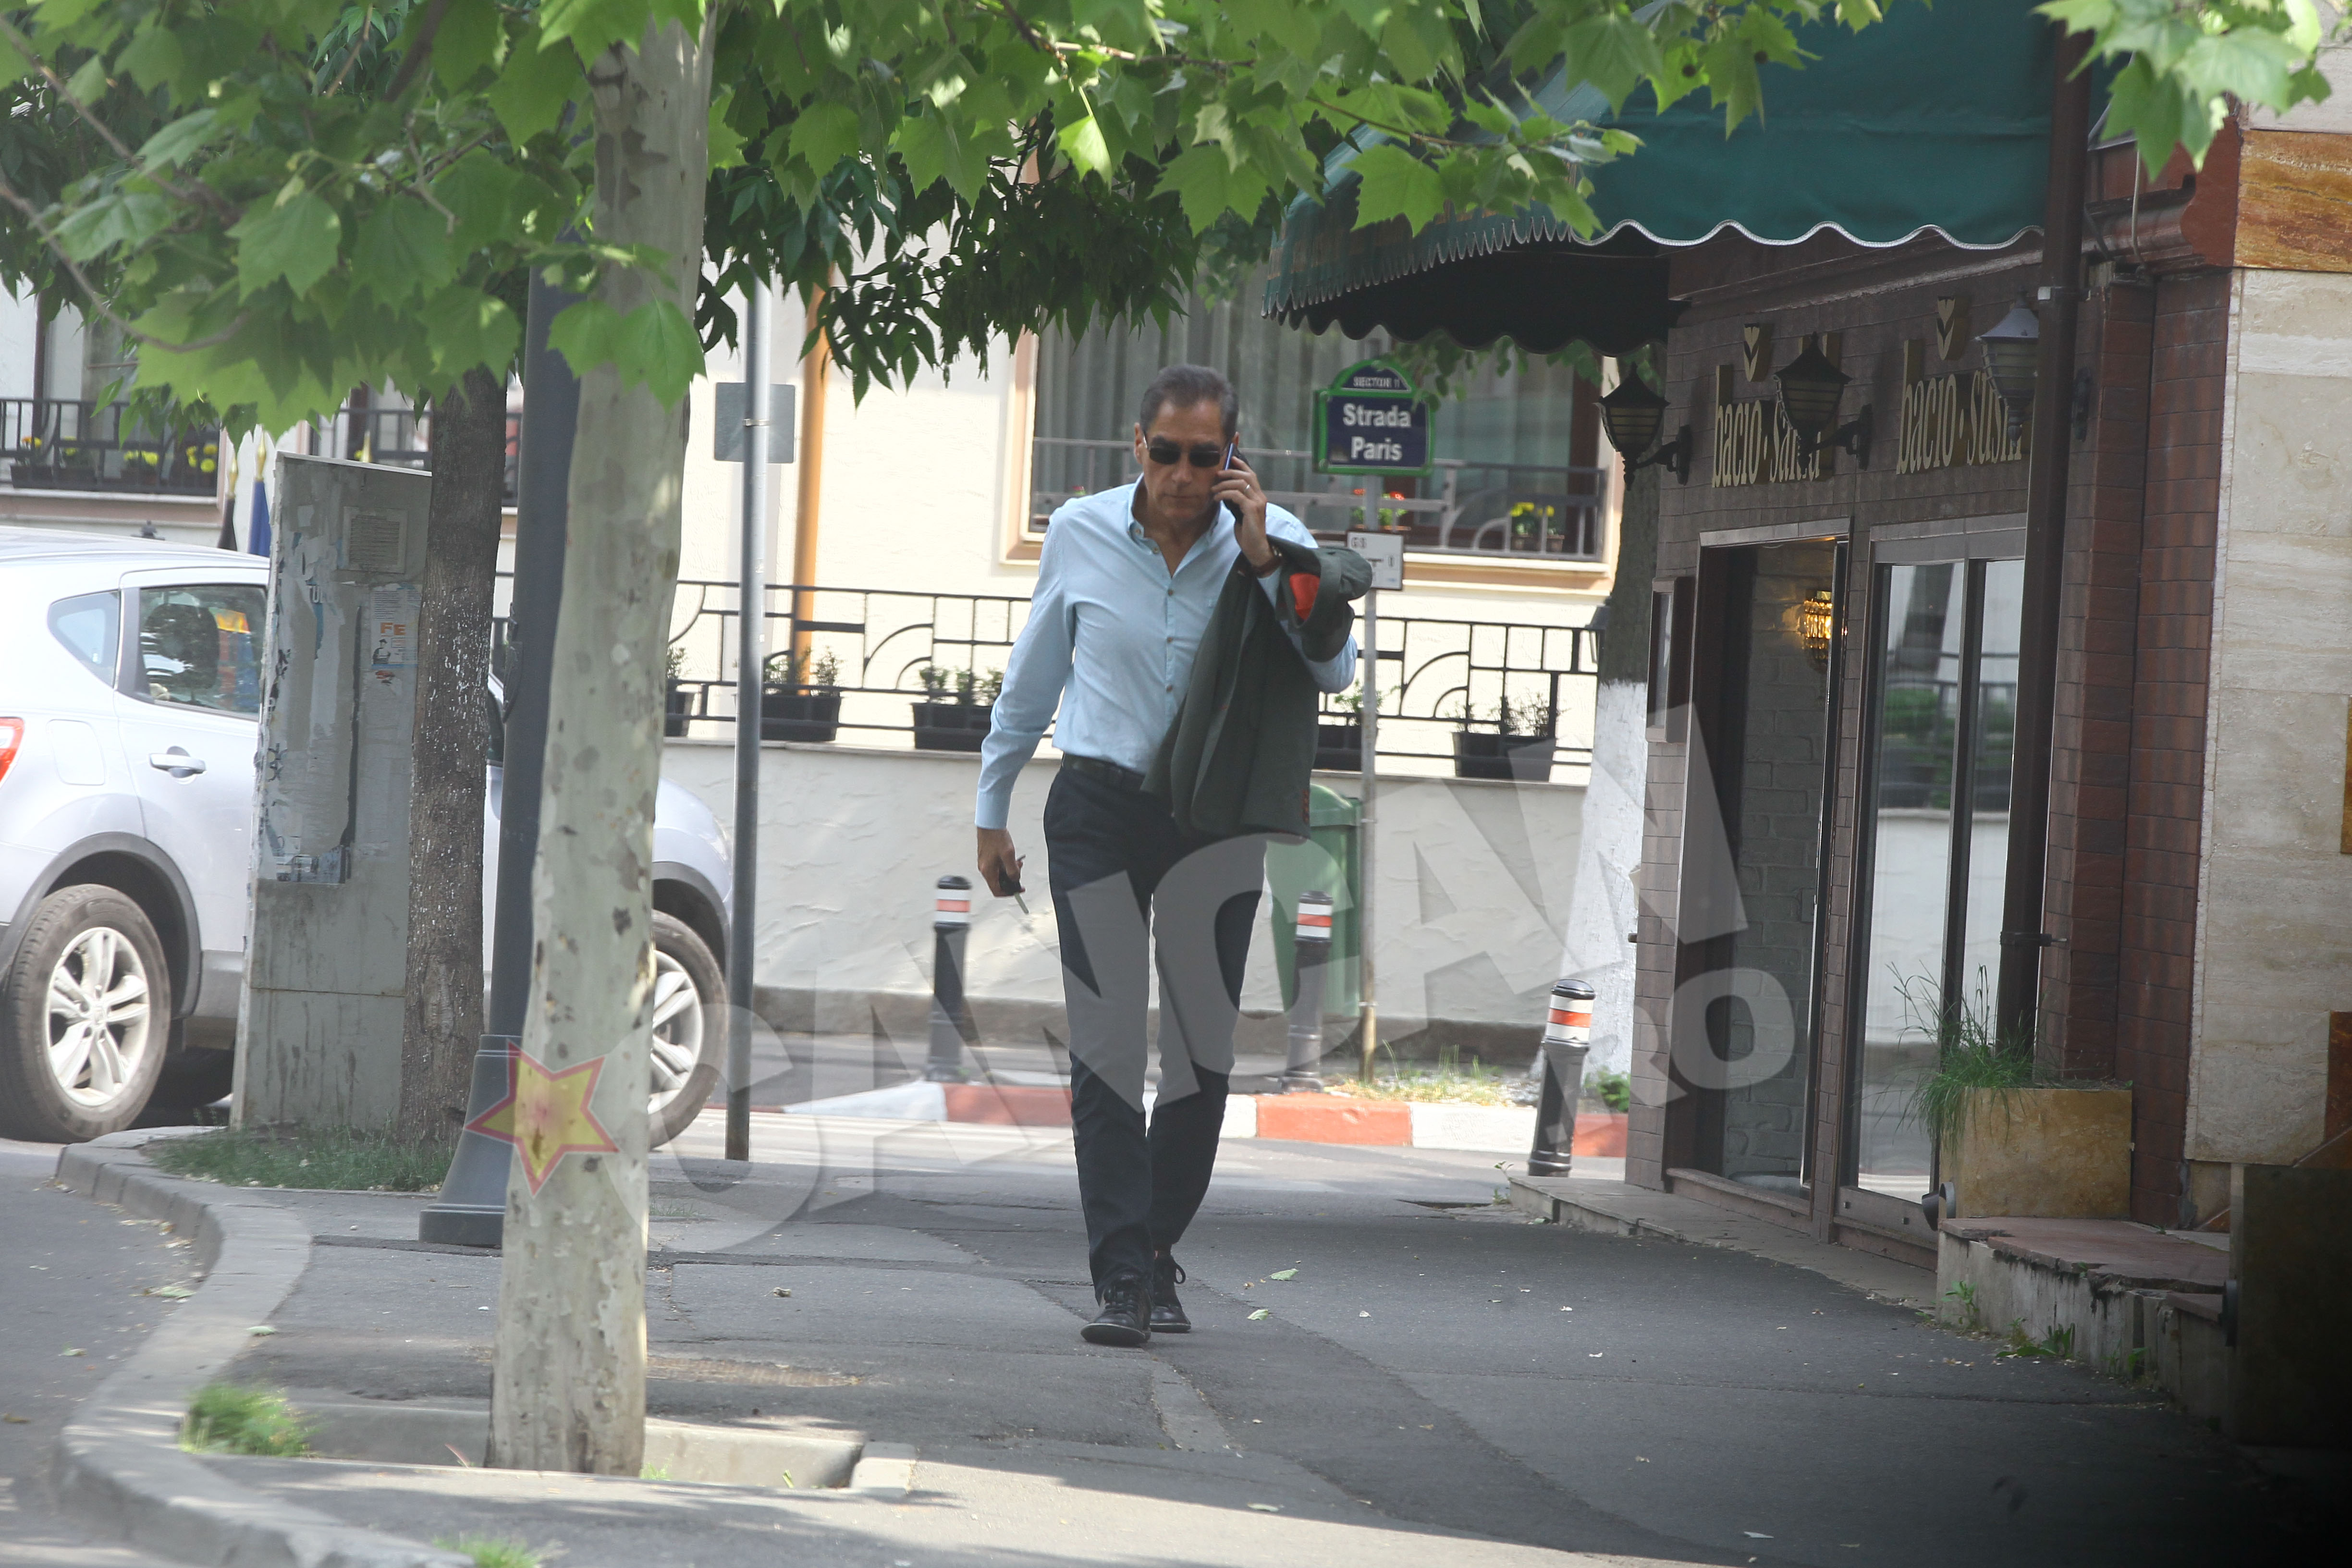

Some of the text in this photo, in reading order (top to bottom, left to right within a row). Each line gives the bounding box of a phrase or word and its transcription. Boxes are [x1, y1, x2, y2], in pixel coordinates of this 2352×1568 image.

[1353, 377, 1392, 388] SECTOR
[1343, 403, 1412, 428] Strada
[1351, 436, 1402, 461] Paris
